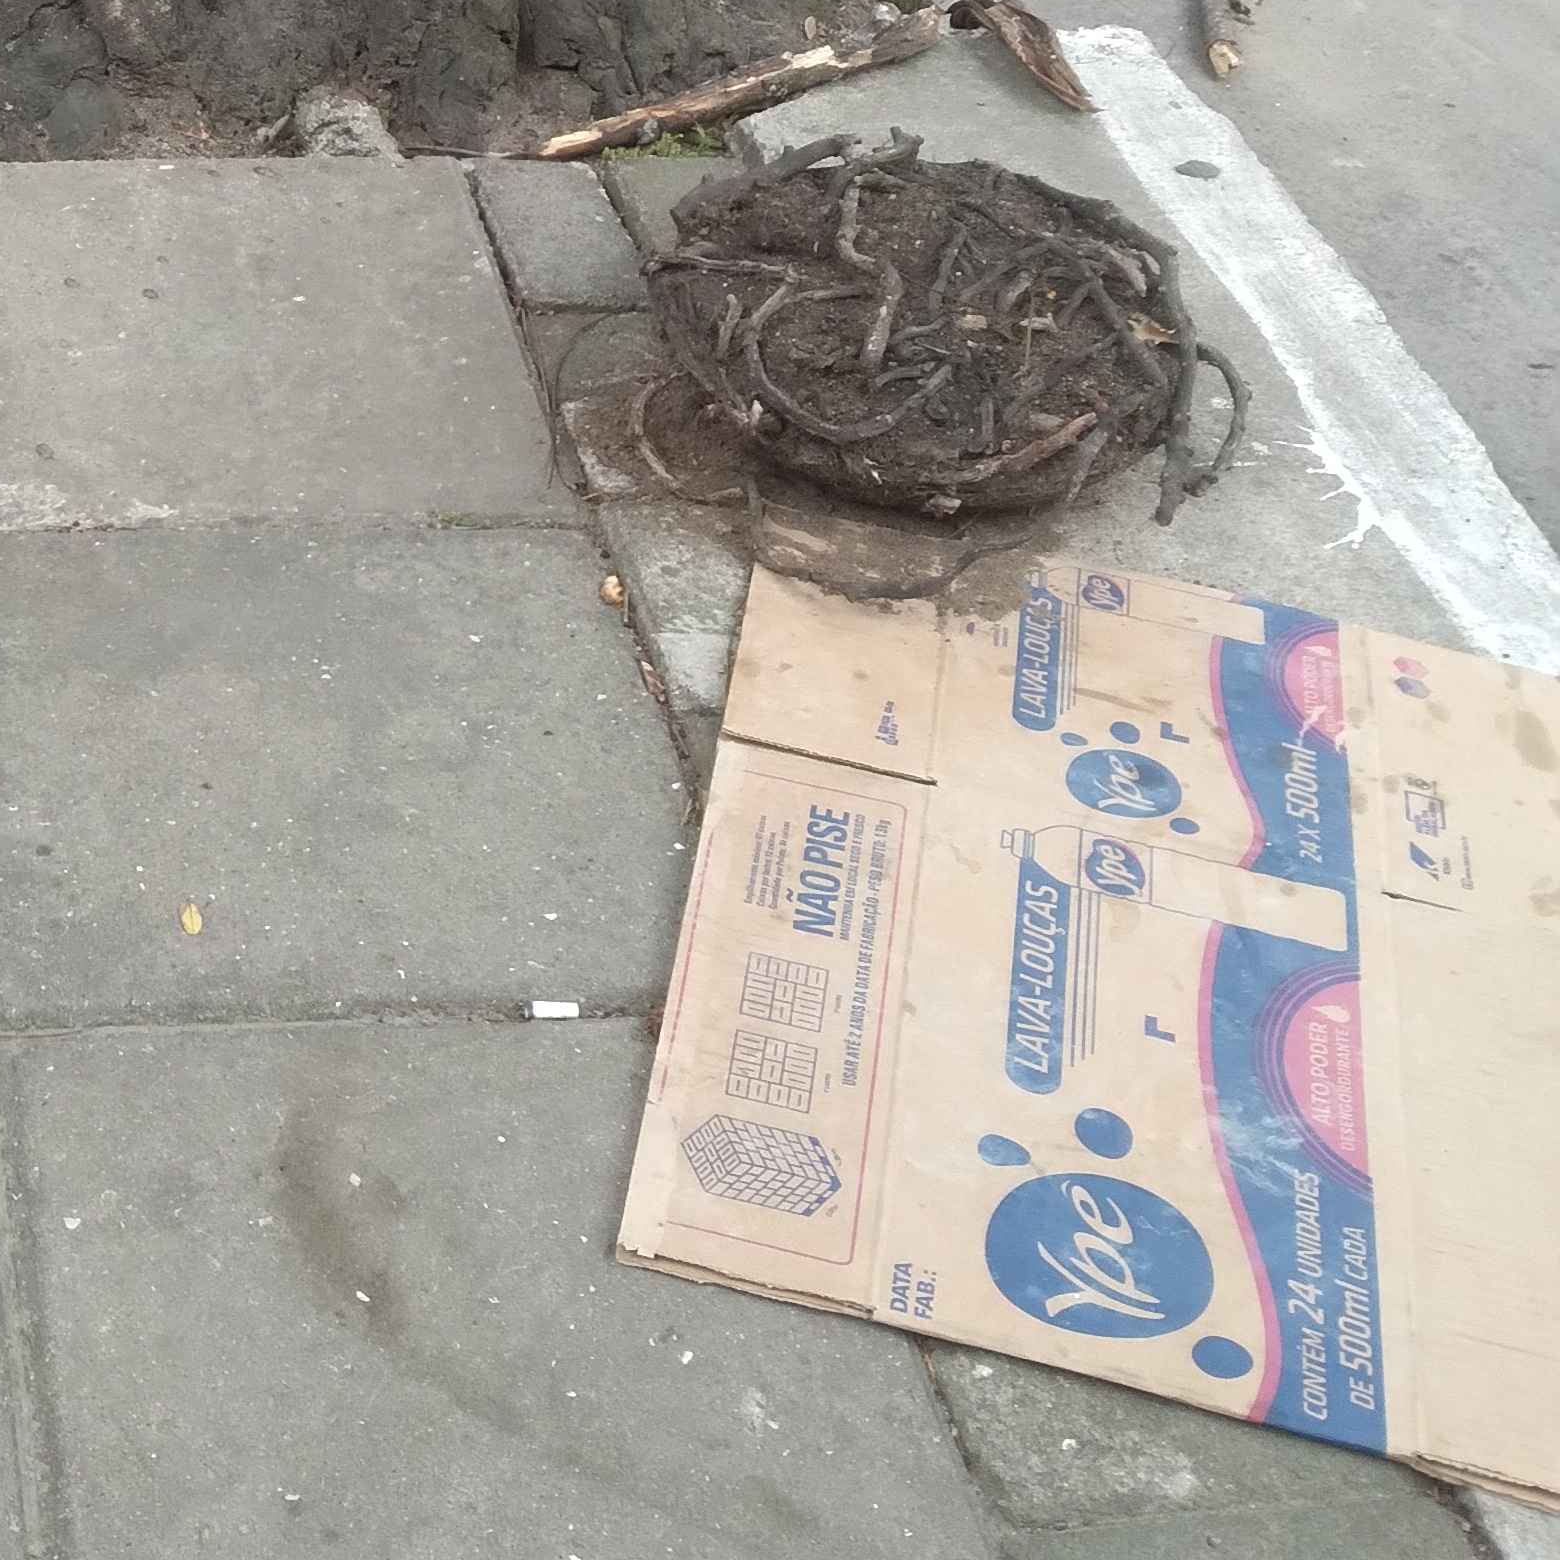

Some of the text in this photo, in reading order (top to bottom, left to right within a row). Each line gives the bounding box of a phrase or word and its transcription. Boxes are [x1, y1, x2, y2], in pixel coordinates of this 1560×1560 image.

[1019, 597, 1058, 719] LAVA-LOUÇS
[1302, 655, 1318, 688] PODER
[1281, 742, 1320, 824] 500ml
[854, 814, 865, 840] FRESCO
[850, 846, 862, 863] SECO
[870, 839, 886, 869] BRUTO:
[1299, 840, 1323, 863] 24
[786, 804, 850, 938] NÃO PISE
[846, 864, 858, 886] LOCAL
[868, 870, 883, 891] PESO
[845, 886, 856, 898] EM
[839, 898, 855, 940] MANTENHA
[859, 897, 882, 951] FABRICAÇÃO
[858, 952, 872, 964] DE
[854, 965, 871, 989] DATA
[1013, 880, 1066, 1074] LAVA-LOUÇAS
[853, 991, 867, 1004] DA
[849, 1005, 866, 1031] ANOS
[842, 1039, 861, 1059] ATÉ
[849, 1031, 862, 1039] 2
[842, 1060, 858, 1086] USAR
[1308, 1022, 1332, 1126] ALTO PODER
[1335, 1028, 1356, 1152] DESENGORDURANTE
[1037, 1180, 1166, 1320] Ypê
[889, 1262, 912, 1314] DATA
[914, 1270, 937, 1320] FAB.:
[1288, 1171, 1328, 1420] CONTÉM 24 UNIDADES
[1334, 1226, 1376, 1410] DE 500ml CADA
